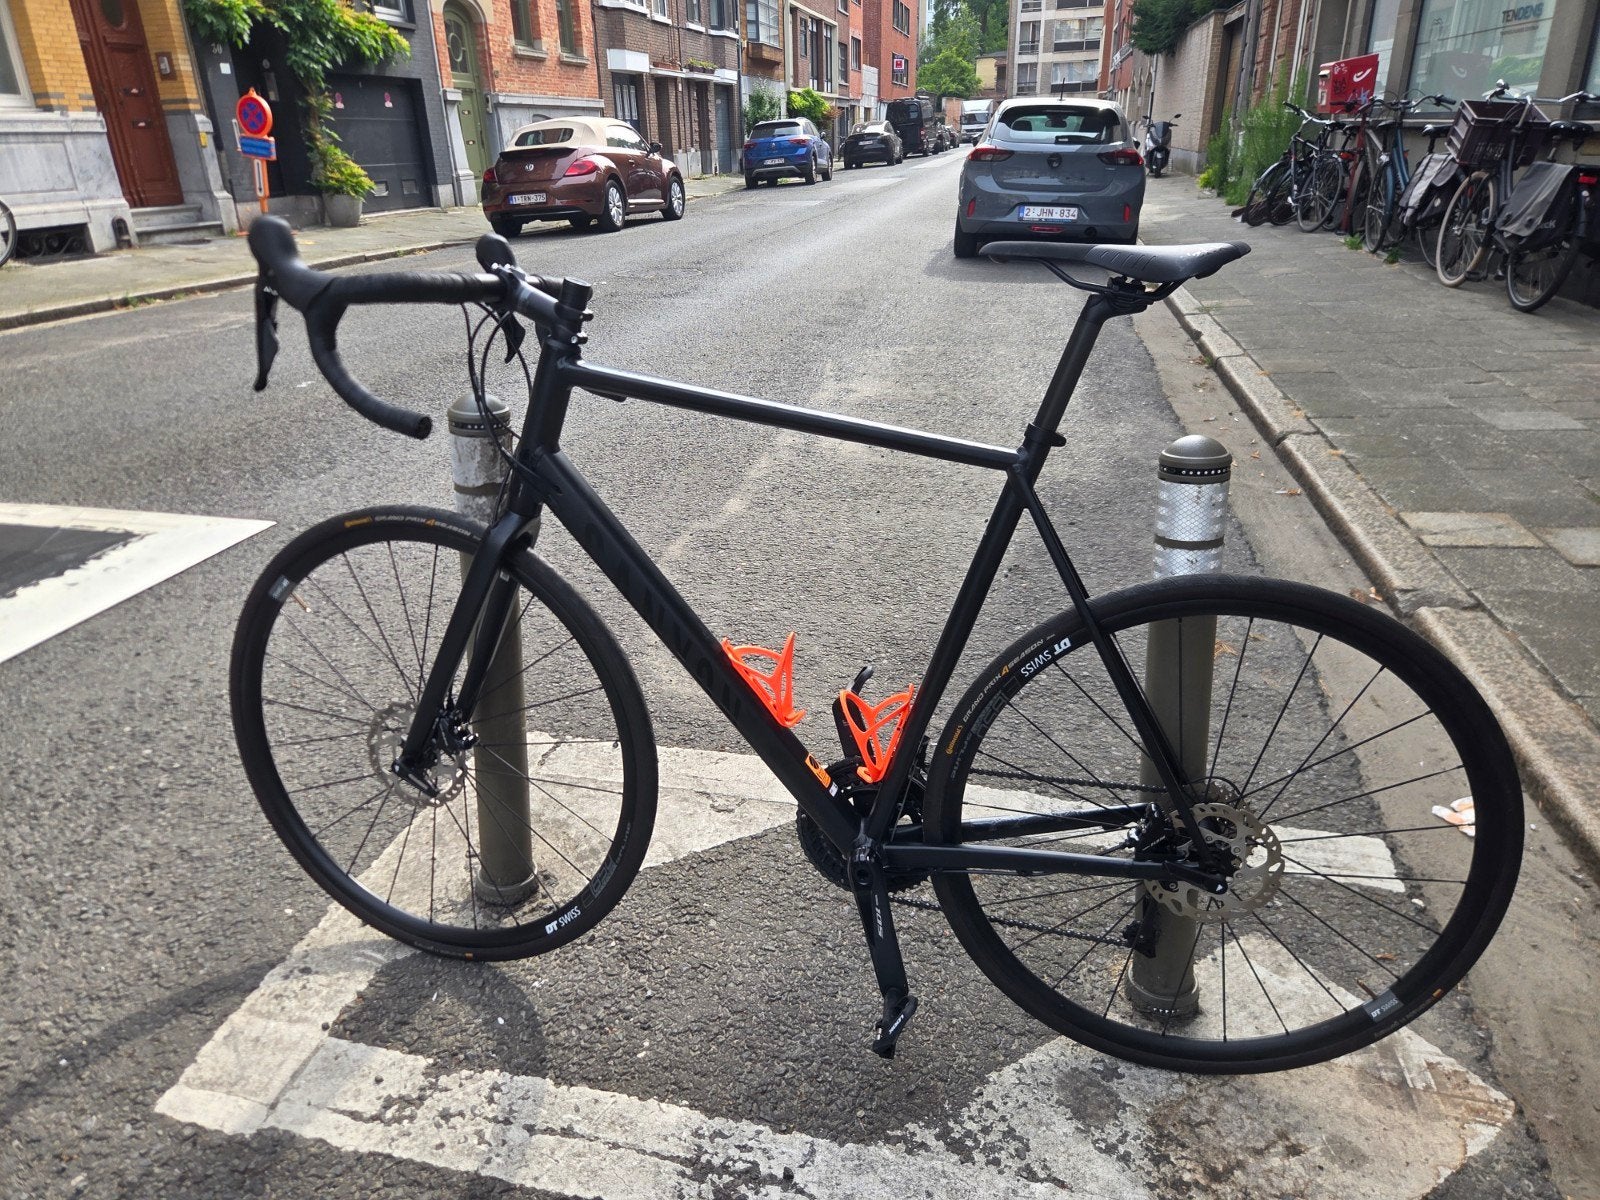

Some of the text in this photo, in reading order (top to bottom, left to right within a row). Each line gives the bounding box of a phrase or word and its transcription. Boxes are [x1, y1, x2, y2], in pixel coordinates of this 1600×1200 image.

[1502, 3, 1544, 23] TENDENS
[1025, 207, 1076, 218] 2-JHN-834
[1020, 637, 1072, 677] DT SWISS
[962, 692, 985, 723] GRAND
[983, 672, 1003, 694] PRIX
[1008, 638, 1045, 668] SEASON
[545, 905, 581, 935] DT SWISS
[1371, 997, 1399, 1019] DT SWISS
